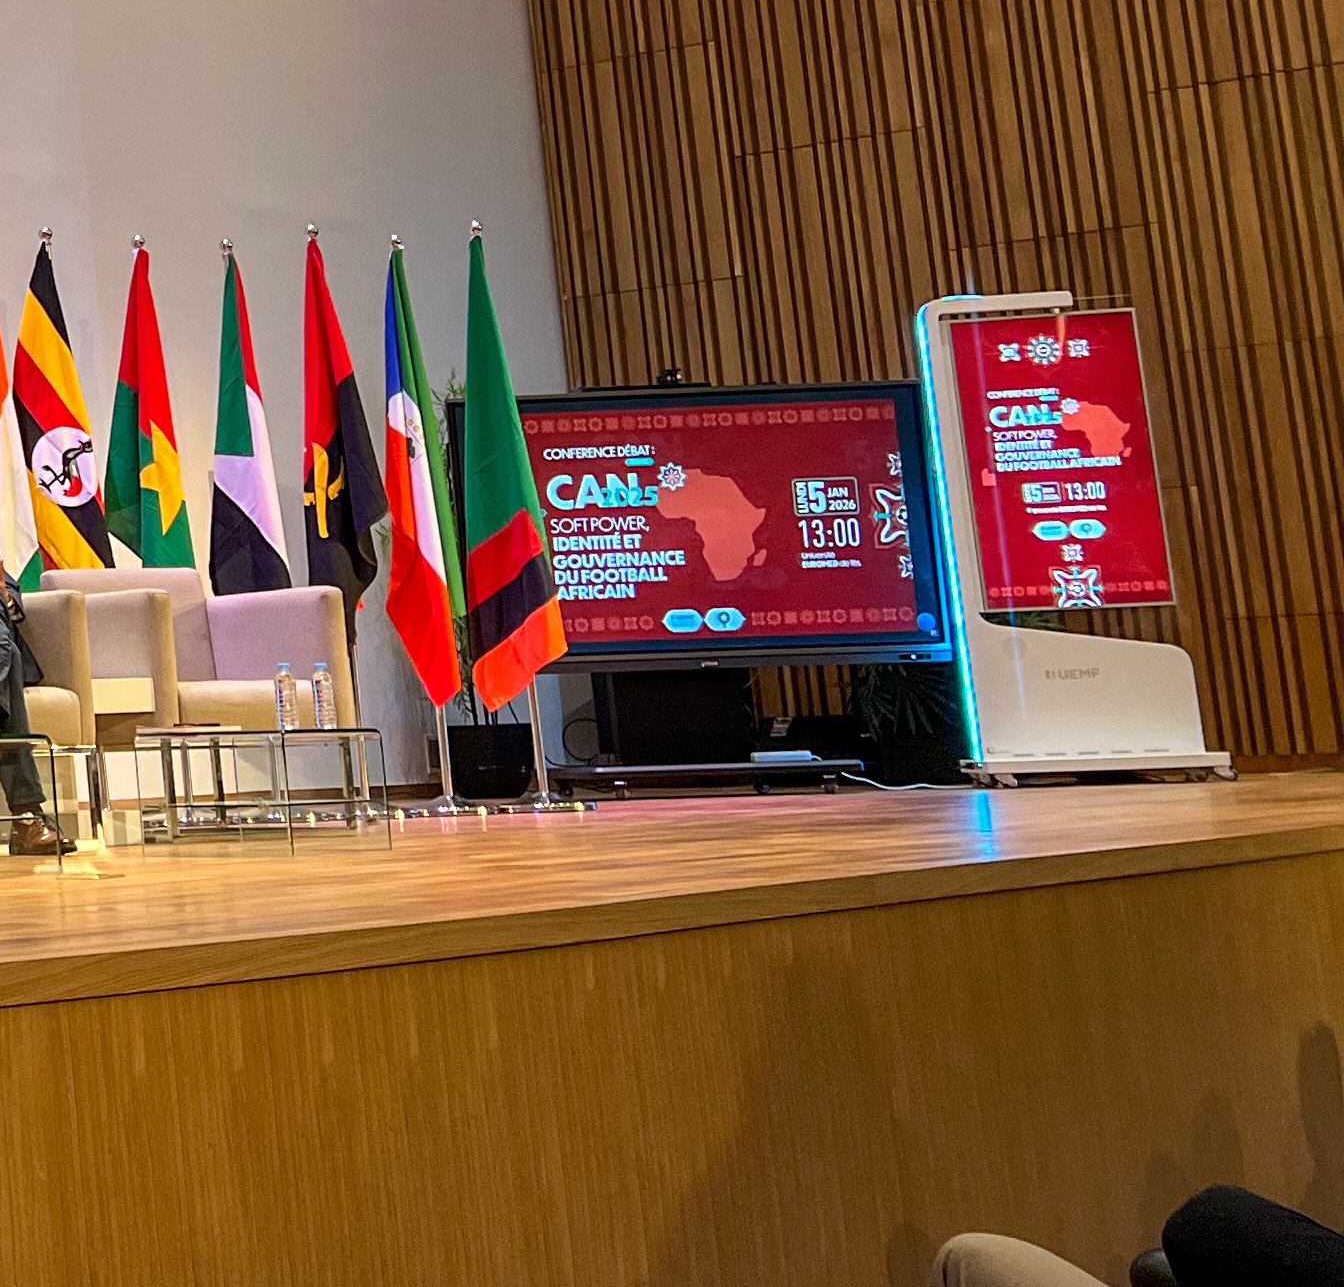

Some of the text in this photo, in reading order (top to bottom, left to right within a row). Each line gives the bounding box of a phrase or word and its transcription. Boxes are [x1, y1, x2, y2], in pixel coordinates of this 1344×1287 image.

[989, 404, 1051, 427] CAN
[543, 445, 616, 460] CONFERENCE
[995, 448, 1081, 462] GOUVERNANCE
[546, 473, 640, 510] CAN
[600, 486, 659, 507] 2025
[808, 481, 826, 513] 5
[827, 487, 849, 498] JAN
[1065, 481, 1106, 501] 13:00
[828, 500, 856, 511] 2026
[550, 515, 650, 534] SOFT POWER,
[798, 518, 861, 548] 13:00
[552, 532, 642, 552] IDENTITÉ ET
[552, 550, 686, 570] GOUVERNANCE
[554, 566, 668, 586] DU FOOTBALL
[557, 584, 636, 601] AFRICAIN
